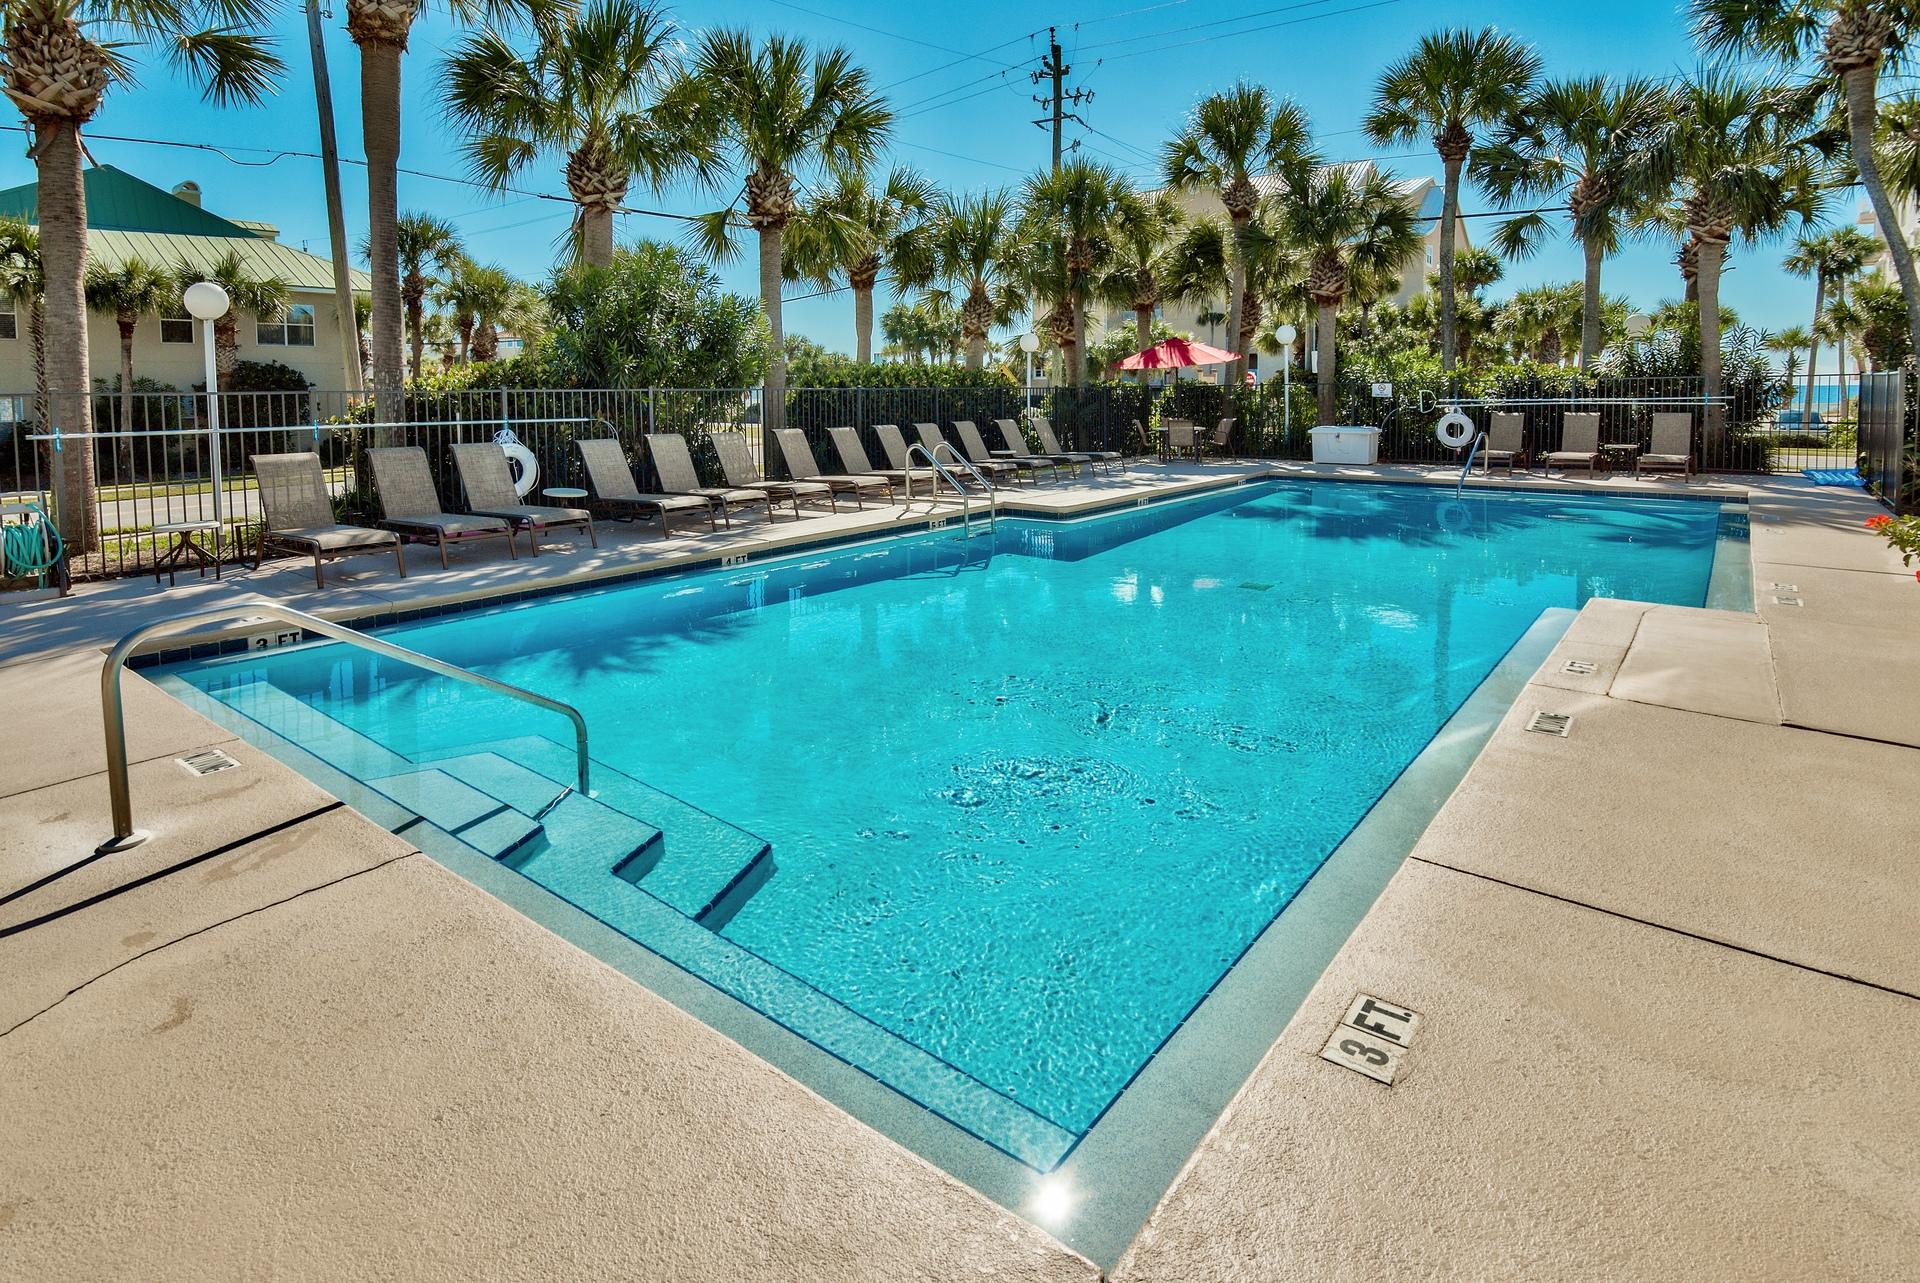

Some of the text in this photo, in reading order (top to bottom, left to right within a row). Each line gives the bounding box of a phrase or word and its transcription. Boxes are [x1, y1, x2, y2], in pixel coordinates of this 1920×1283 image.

[277, 631, 300, 645] FT
[1339, 998, 1413, 1066] 3 FT.
